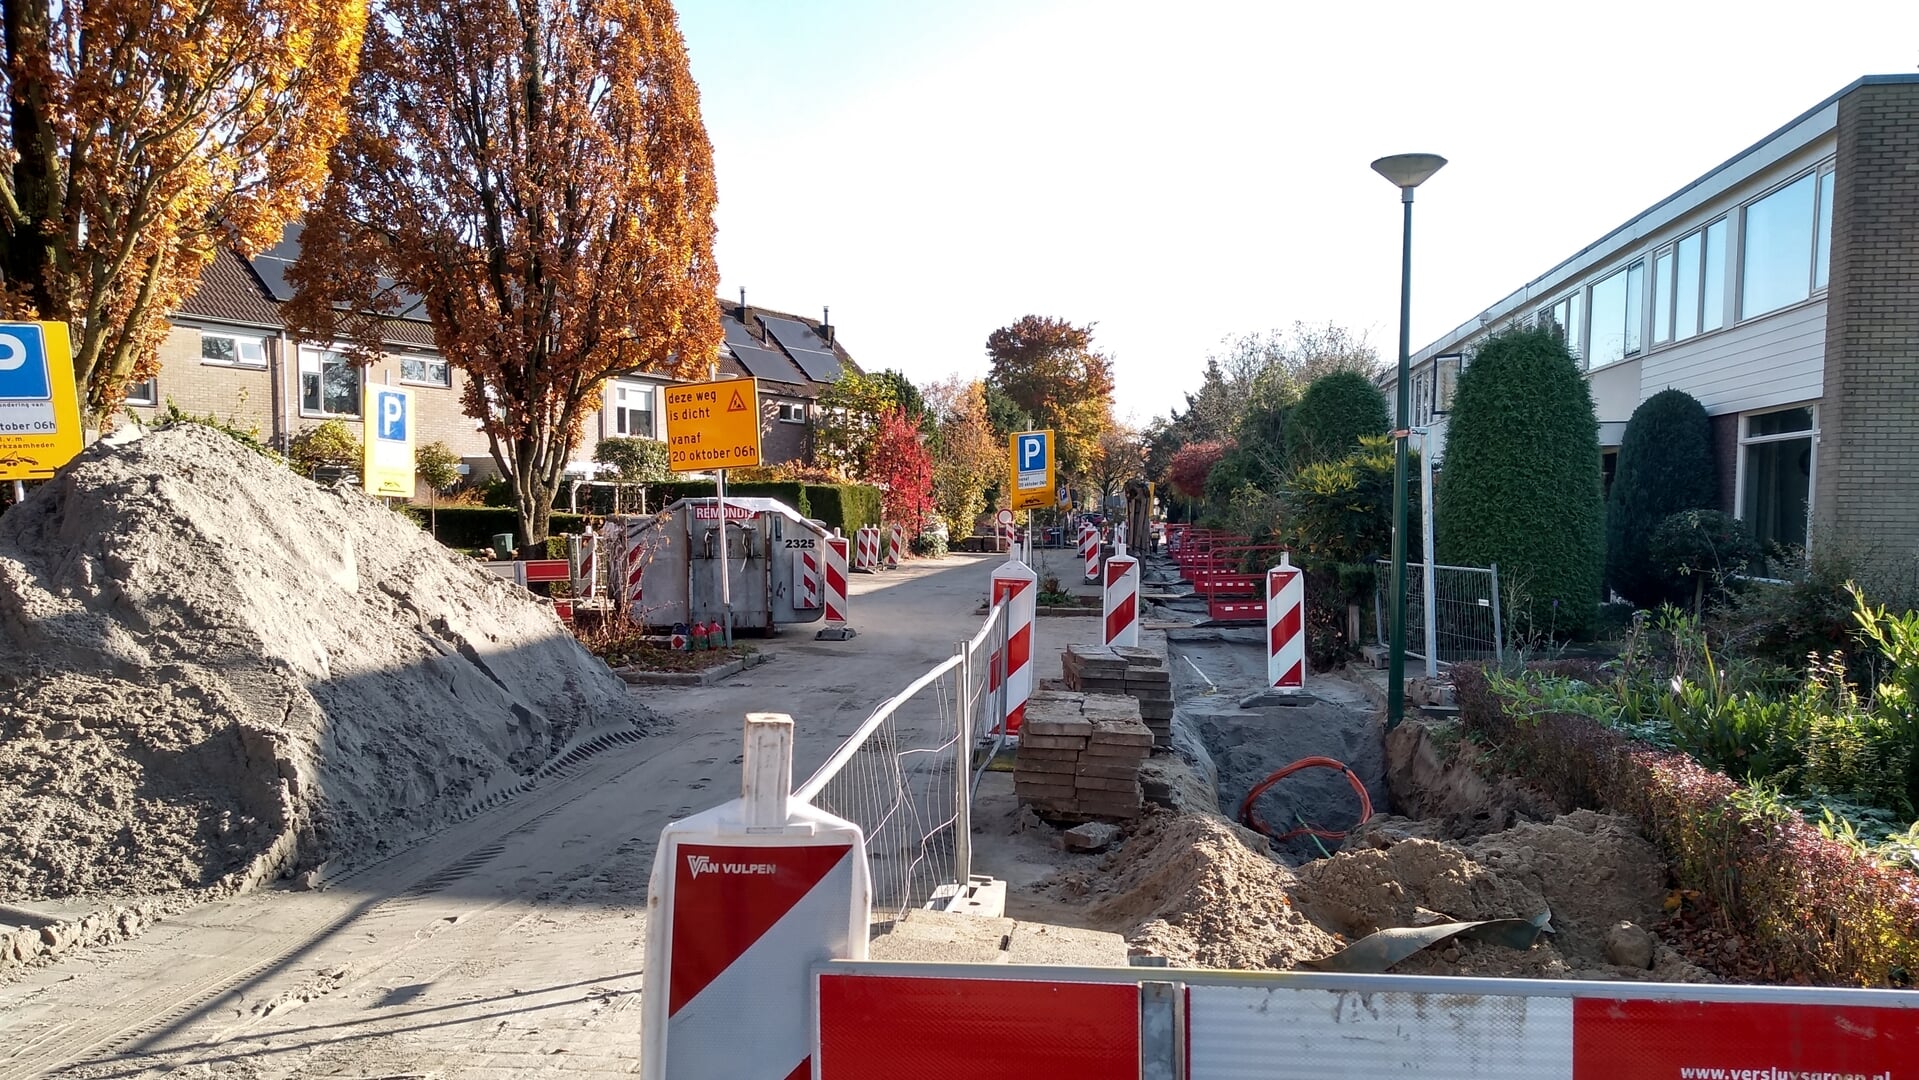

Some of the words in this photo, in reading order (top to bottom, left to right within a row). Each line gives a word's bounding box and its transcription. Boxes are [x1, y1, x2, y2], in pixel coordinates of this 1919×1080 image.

[668, 393, 692, 404] deze
[696, 391, 717, 403] weg
[384, 396, 402, 436] P
[669, 411, 679, 421] is
[682, 407, 710, 420] dicht
[34, 421, 56, 430] 06h
[671, 432, 701, 445] vanaf
[672, 451, 686, 462] 20
[689, 448, 730, 461] oktober
[734, 446, 756, 458] 06h
[1025, 439, 1040, 468] P
[1061, 489, 1066, 500] P
[785, 539, 815, 548] 2325
[687, 855, 719, 880] VAN
[723, 863, 777, 874] VULPEN
